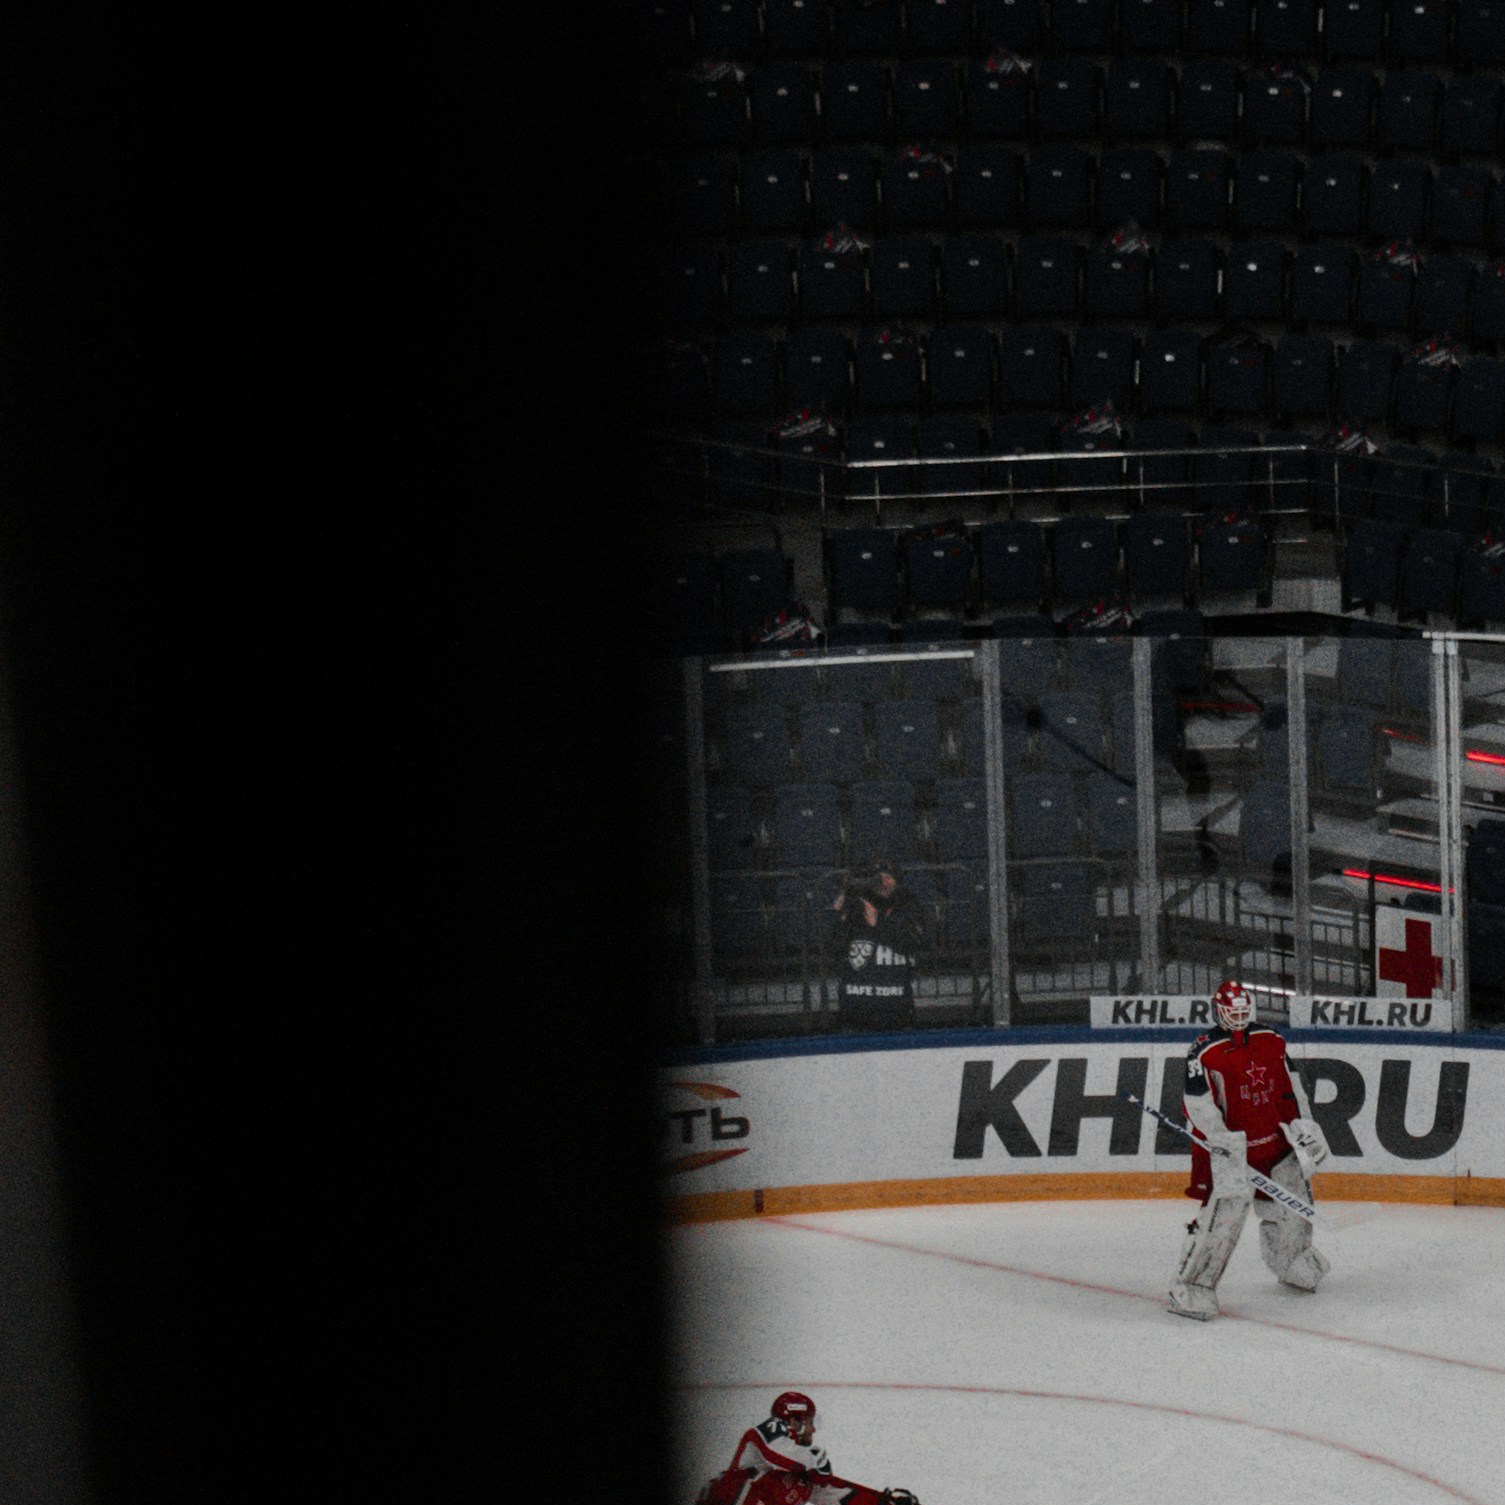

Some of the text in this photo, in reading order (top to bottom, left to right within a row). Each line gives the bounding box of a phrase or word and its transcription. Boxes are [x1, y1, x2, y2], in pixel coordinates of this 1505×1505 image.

[1111, 1000, 1209, 1025] KHL.R
[1310, 1000, 1432, 1027] KHL.RU
[952, 1057, 1470, 1161] KHLRU
